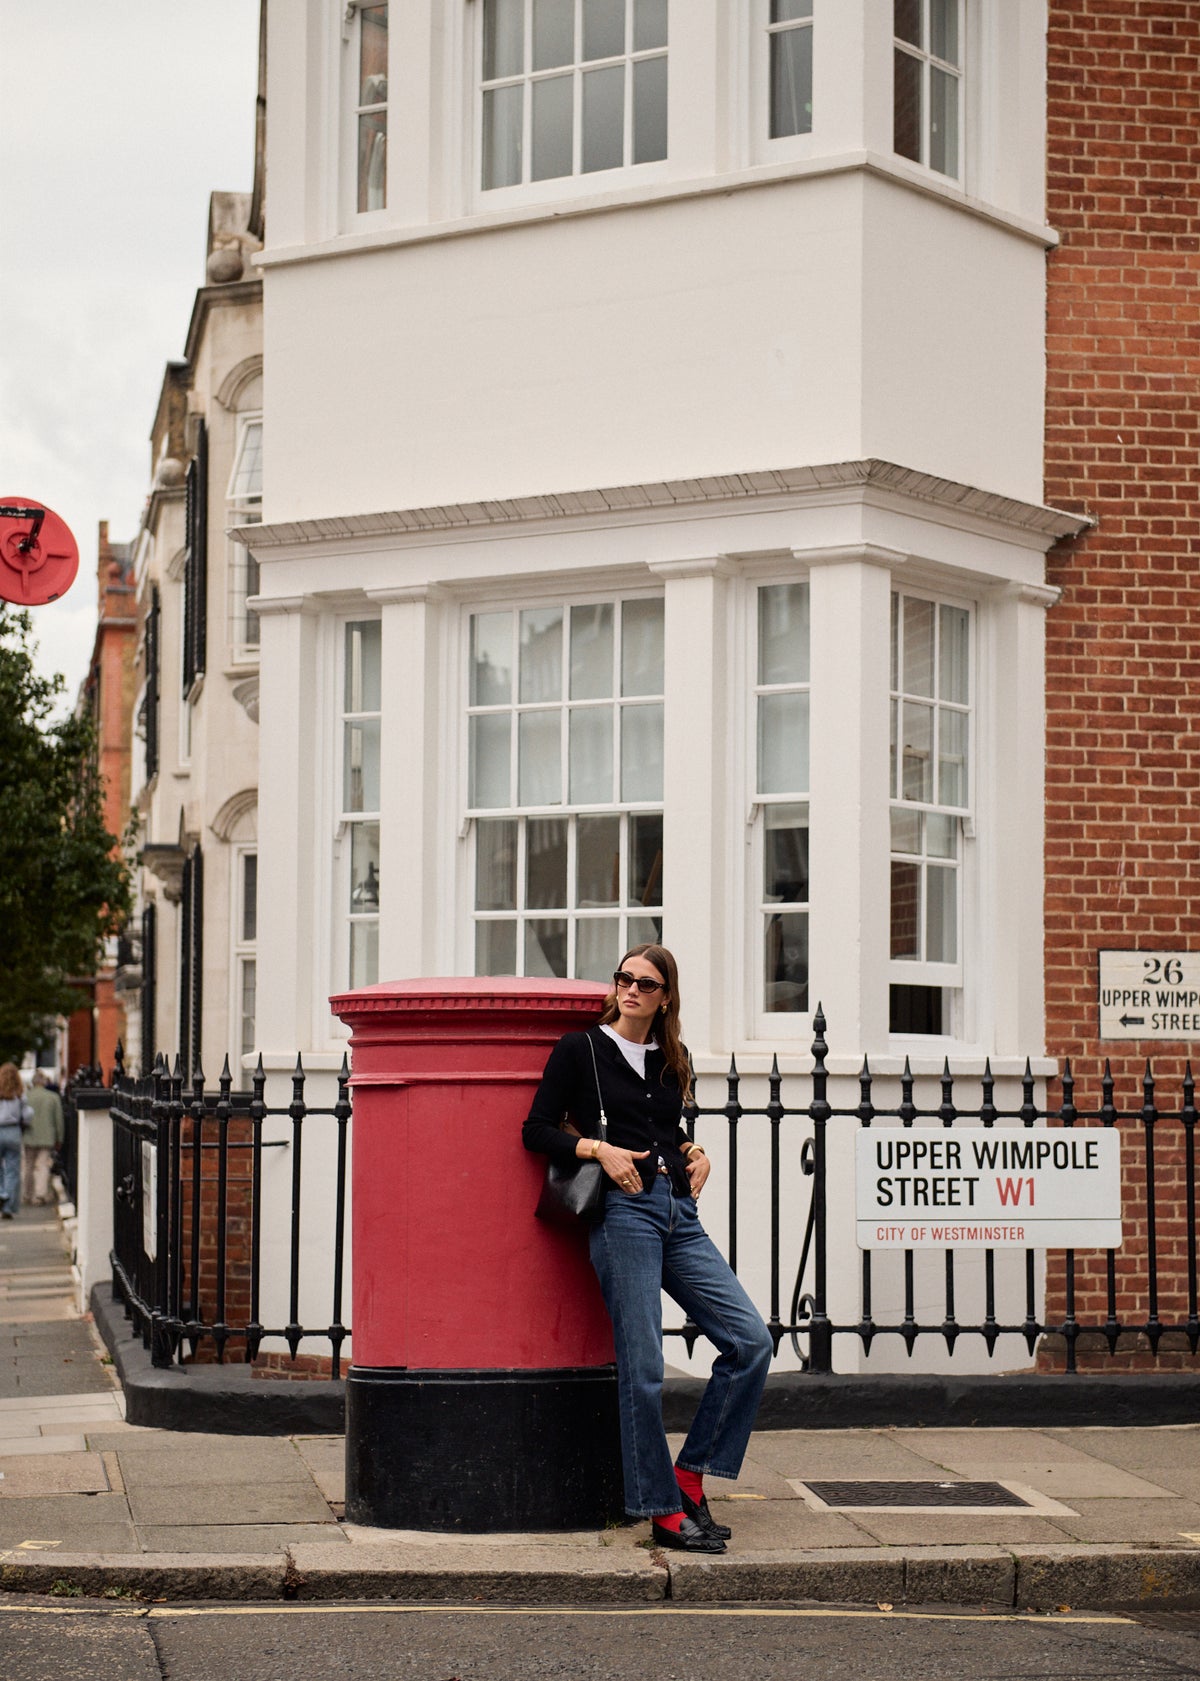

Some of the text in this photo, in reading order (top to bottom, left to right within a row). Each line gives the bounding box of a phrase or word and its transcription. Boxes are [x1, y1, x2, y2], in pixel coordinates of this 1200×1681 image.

[1143, 958, 1183, 985] 26
[1102, 989, 1200, 1008] UPPER WIMP
[876, 1140, 1099, 1170] UPPER WIMPOLE
[876, 1177, 1035, 1207] STREET W1
[877, 1227, 1025, 1241] CITY OF WESTMINSTER
